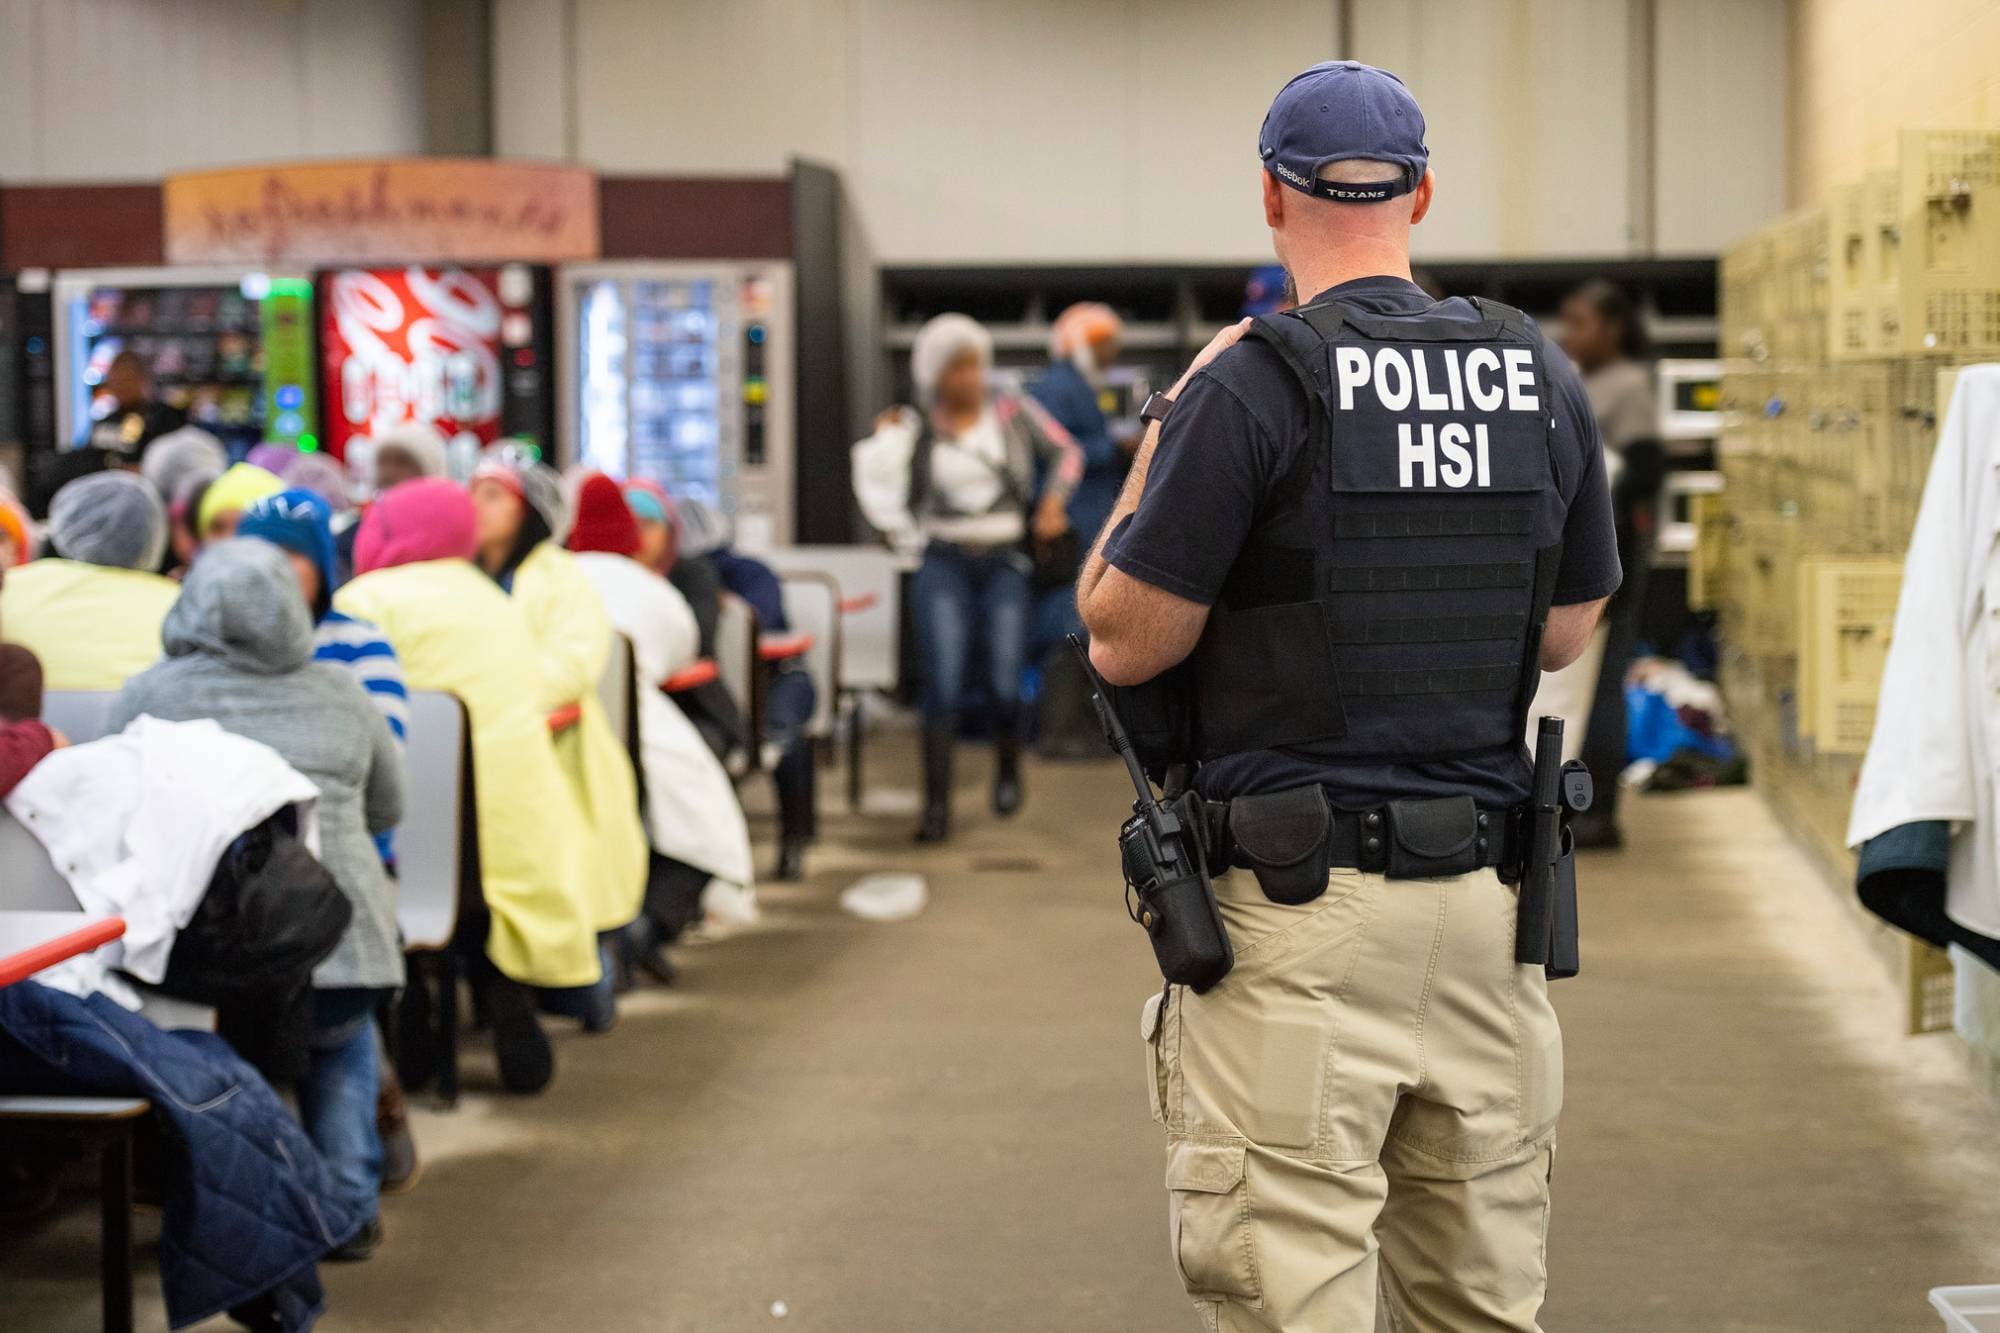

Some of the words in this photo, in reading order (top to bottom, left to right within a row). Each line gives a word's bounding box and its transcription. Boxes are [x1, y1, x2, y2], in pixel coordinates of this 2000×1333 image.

[1276, 163, 1310, 188] Reebok
[1326, 188, 1386, 198] TEXANS
[1335, 347, 1540, 412] POLICE
[1397, 422, 1491, 488] HSI
